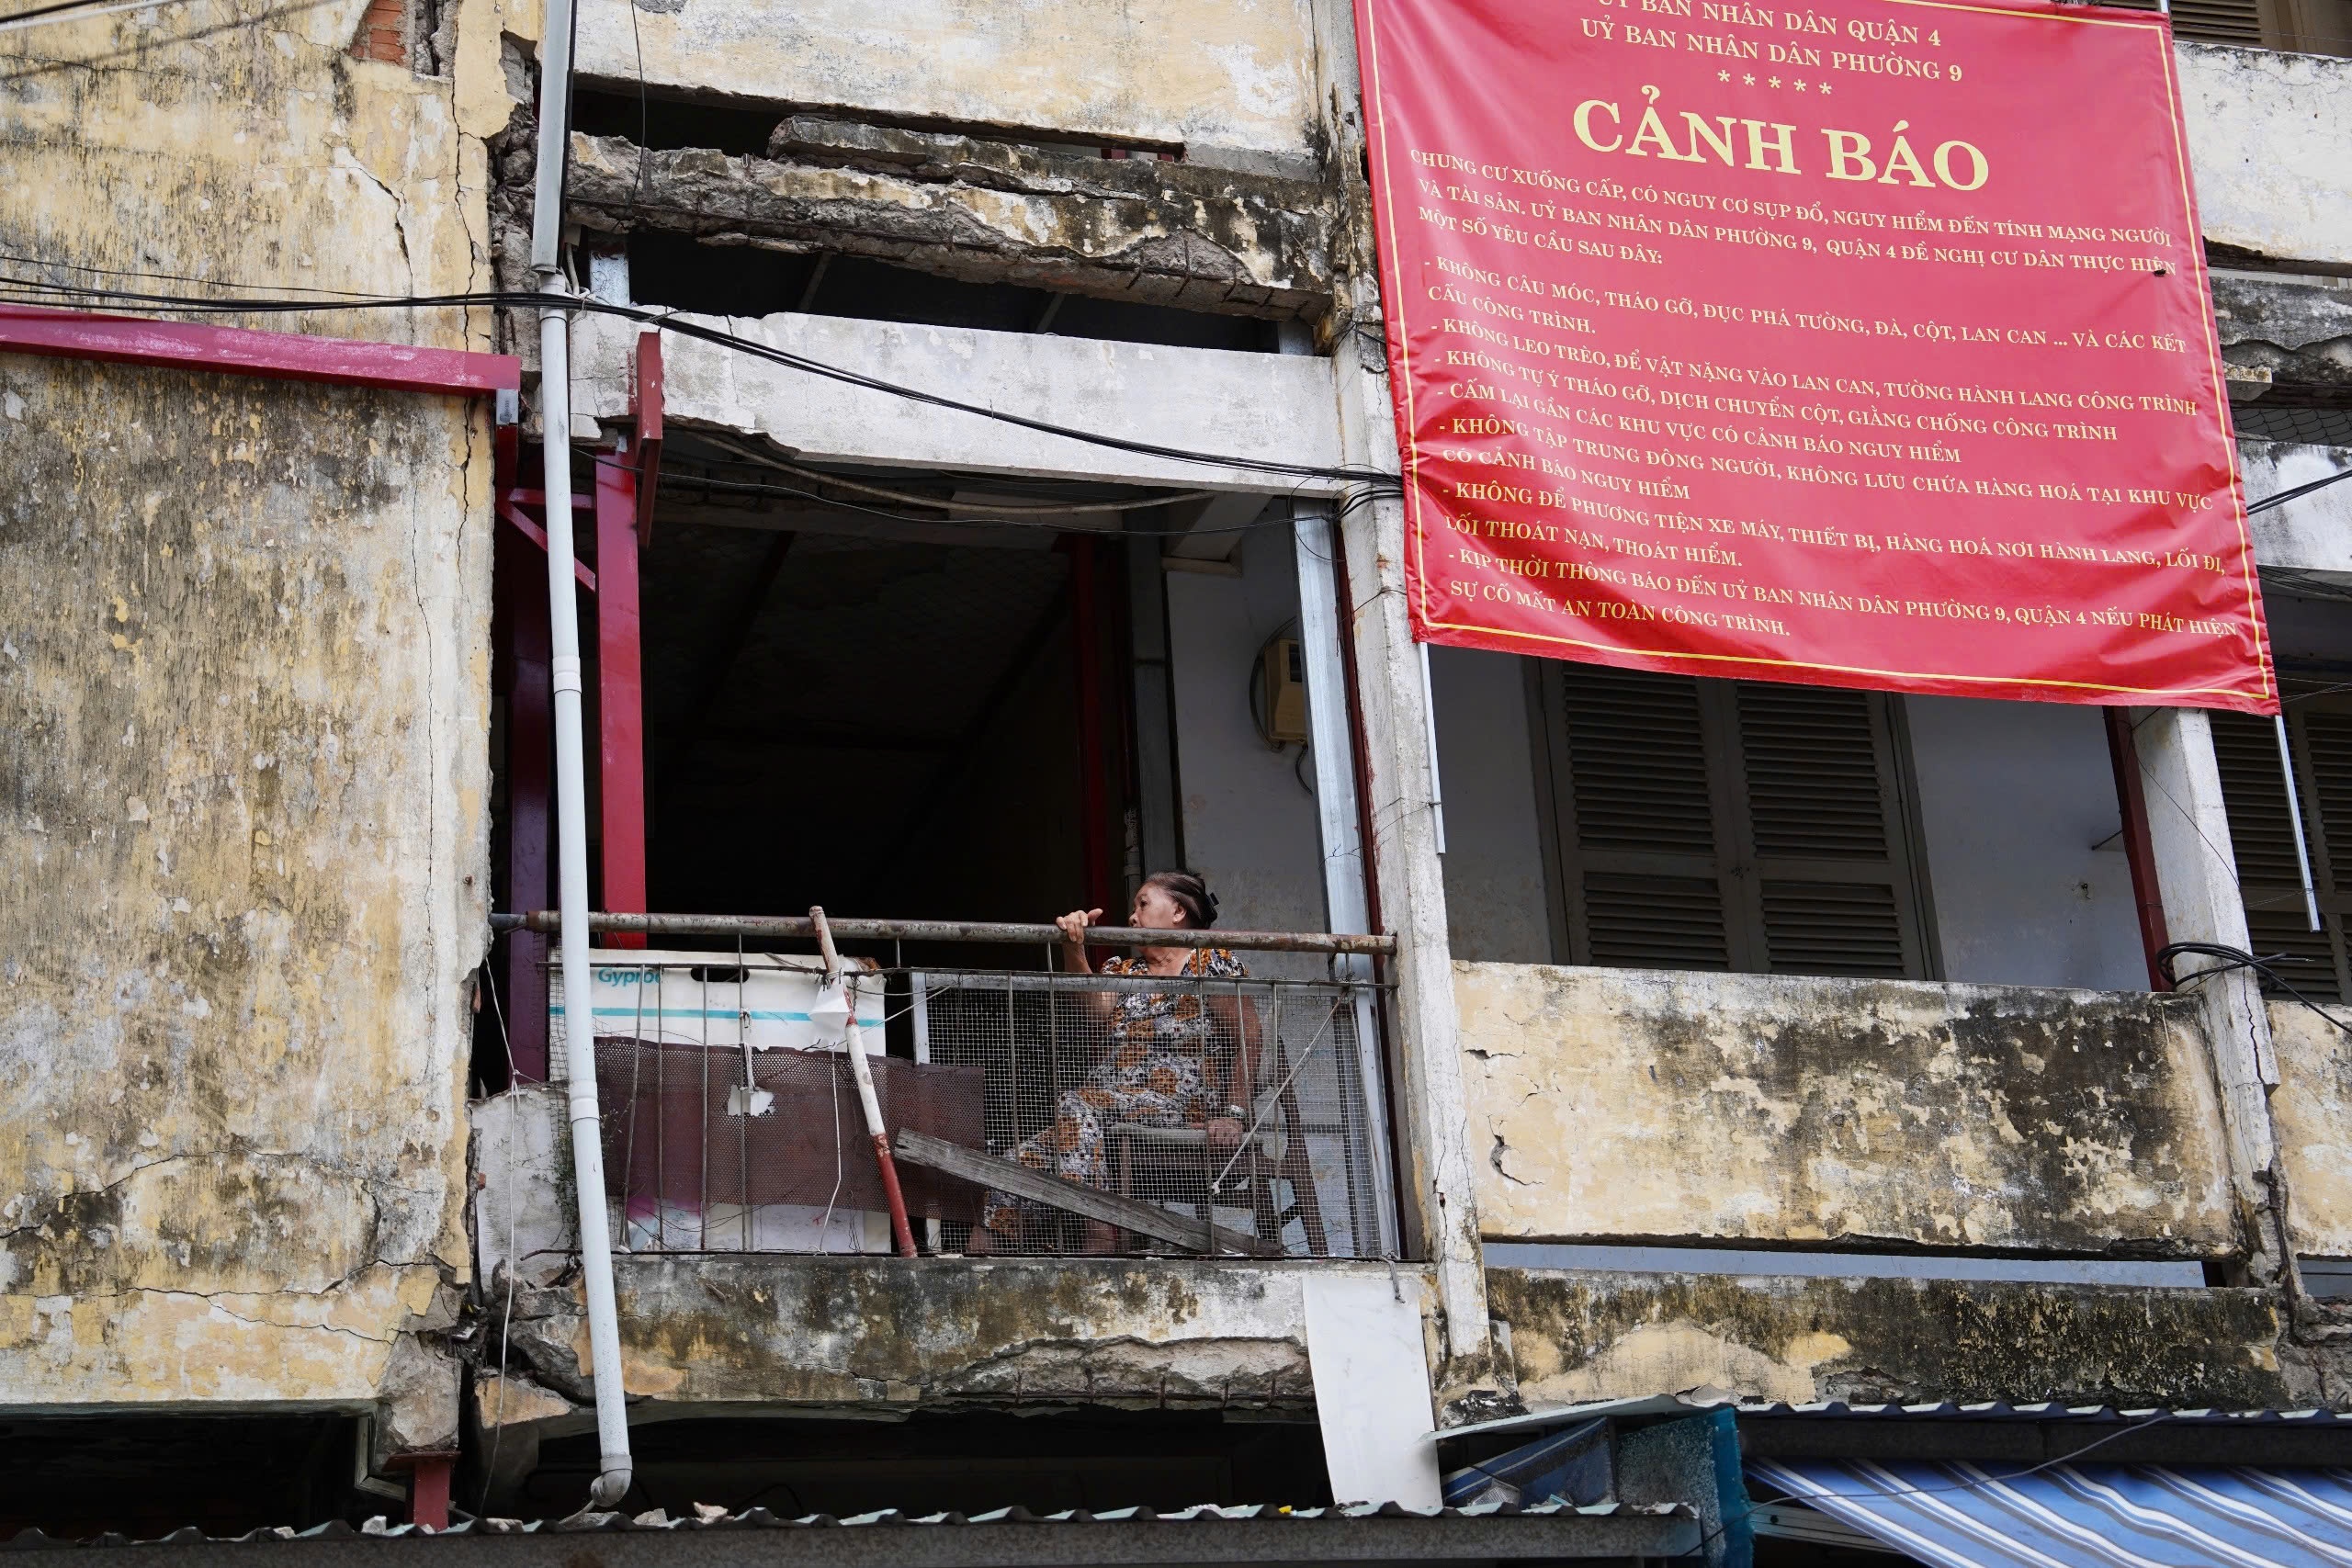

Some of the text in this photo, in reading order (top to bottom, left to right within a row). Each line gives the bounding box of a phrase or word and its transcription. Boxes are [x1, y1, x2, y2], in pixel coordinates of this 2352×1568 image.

[1580, 15, 1962, 81] UỶ BAN NHÂN DÂN PHƯỜNG 9
[1702, 2, 1773, 28] NHÂN
[1784, 9, 1837, 35] DÂN
[1848, 18, 1918, 46] QUẬN
[1928, 29, 1940, 46] 4
[1574, 85, 1988, 190] CẢNH BÁO
[1411, 150, 2172, 247] CHUNG CƯ XUỐNG CẤP, CÓ NGUY CƠ SỤP ĐỔ, NGUY HIỂM ĐẾN TÍNH MẠNG NGƯỜI
[1419, 178, 2124, 273] VÀ TÀI SẢN. UỶ BAN NHÂN DÂN PHƯỜNG 9, QUẬN 4 ĐỀ NGHỊ CƯ DÂN THỰC
[1419, 207, 1662, 264] MỘT SỐ YÊU CẦU SAU ĐÂY:
[1429, 284, 1595, 333] CẤU CÔNG TRÌNH.
[1437, 256, 2186, 353] KHÔNG CÂU MÓC, THÁO GỠ, ĐỤC PHÁ TƯỜNG, ĐÀ, CỘT, LAN CAN VÀ CÁC KẾT
[1442, 319, 2198, 415] KHÔNG LEO TRÈO, ĐỂ VẬT NẶNG VÀO LAN CAN, TƯỜNG HÀNH LANG CÔNG TRÌNH
[1446, 351, 2117, 440] KHÔNG TỰ Ý THÁO GỠ, DỊCH CHUYỂN CỘT, GIẰNG CHỐNG CÔNG TRÌNH
[1450, 378, 1962, 462] CẤM LẠI GẦN CÁC KHU VỰC CÓ CẢNH BÁO NGUY HIỂM
[1453, 414, 2212, 513] KHÔNG TẬP TRUNG ĐÔNG NGƯỜI, KHÔNG LƯU CHỨA HÀNG HOÁ TẠI KHU VỰC
[1455, 479, 2225, 575] KHÔNG ĐỂ PHƯƠNG TIỆN XE MÁY, THIẾT BỊ, HÀNG HOÁ NƠI HÀNH LANG, LỐI ĐI,
[1460, 548, 2238, 638] KỊP THỜI THÔNG BÁO ĐẾN UỶ BAN NHÂN DÂN PHƯỜNG 9, QUẬN 4 NẾU PHÁT HIỆN
